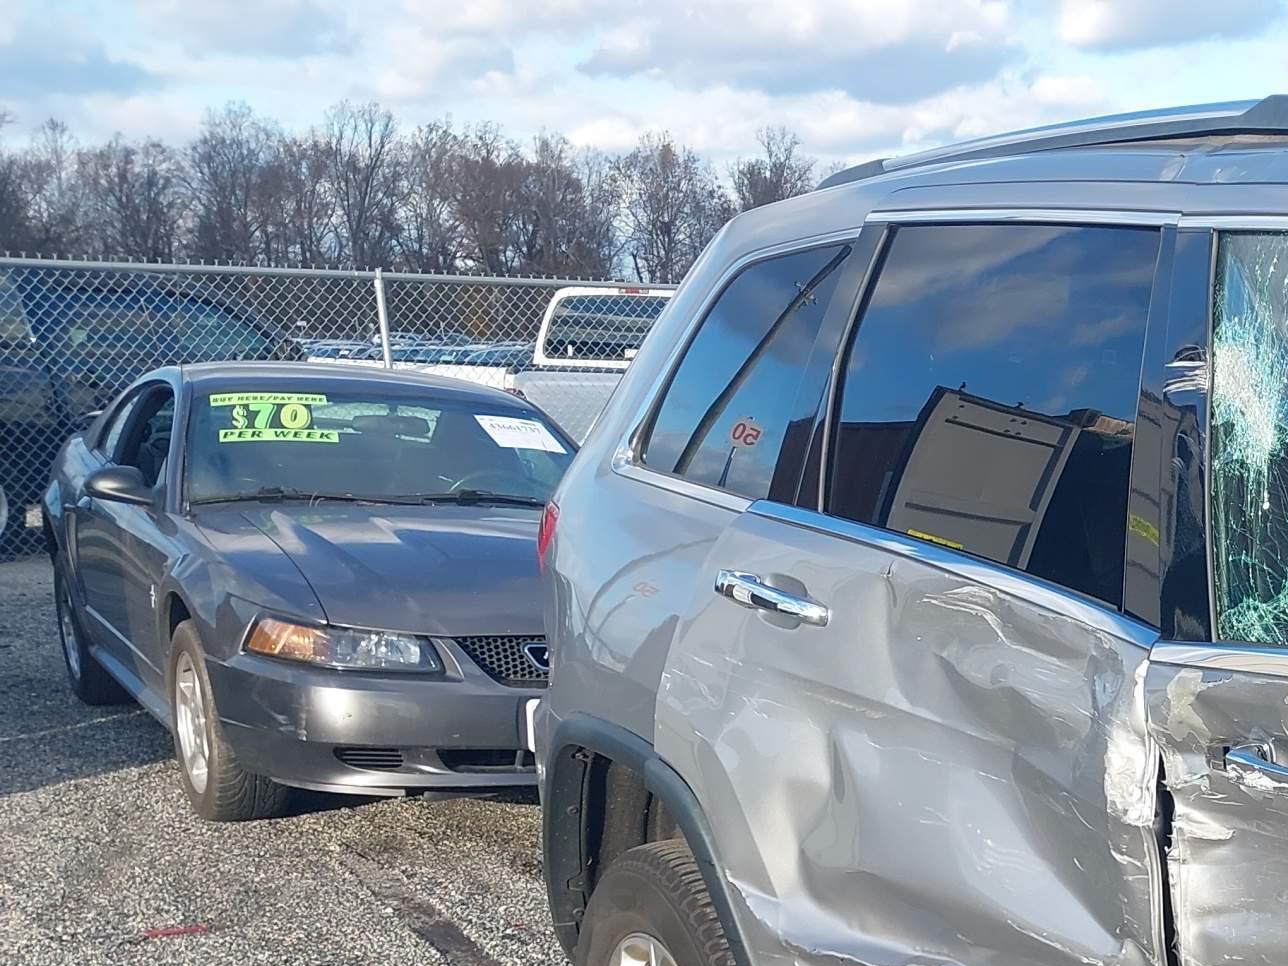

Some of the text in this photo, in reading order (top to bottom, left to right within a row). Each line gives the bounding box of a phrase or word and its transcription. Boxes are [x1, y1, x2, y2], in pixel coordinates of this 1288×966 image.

[237, 394, 294, 402] HERE/PAY
[231, 404, 311, 429] $70
[222, 430, 333, 440] PER WEEK
